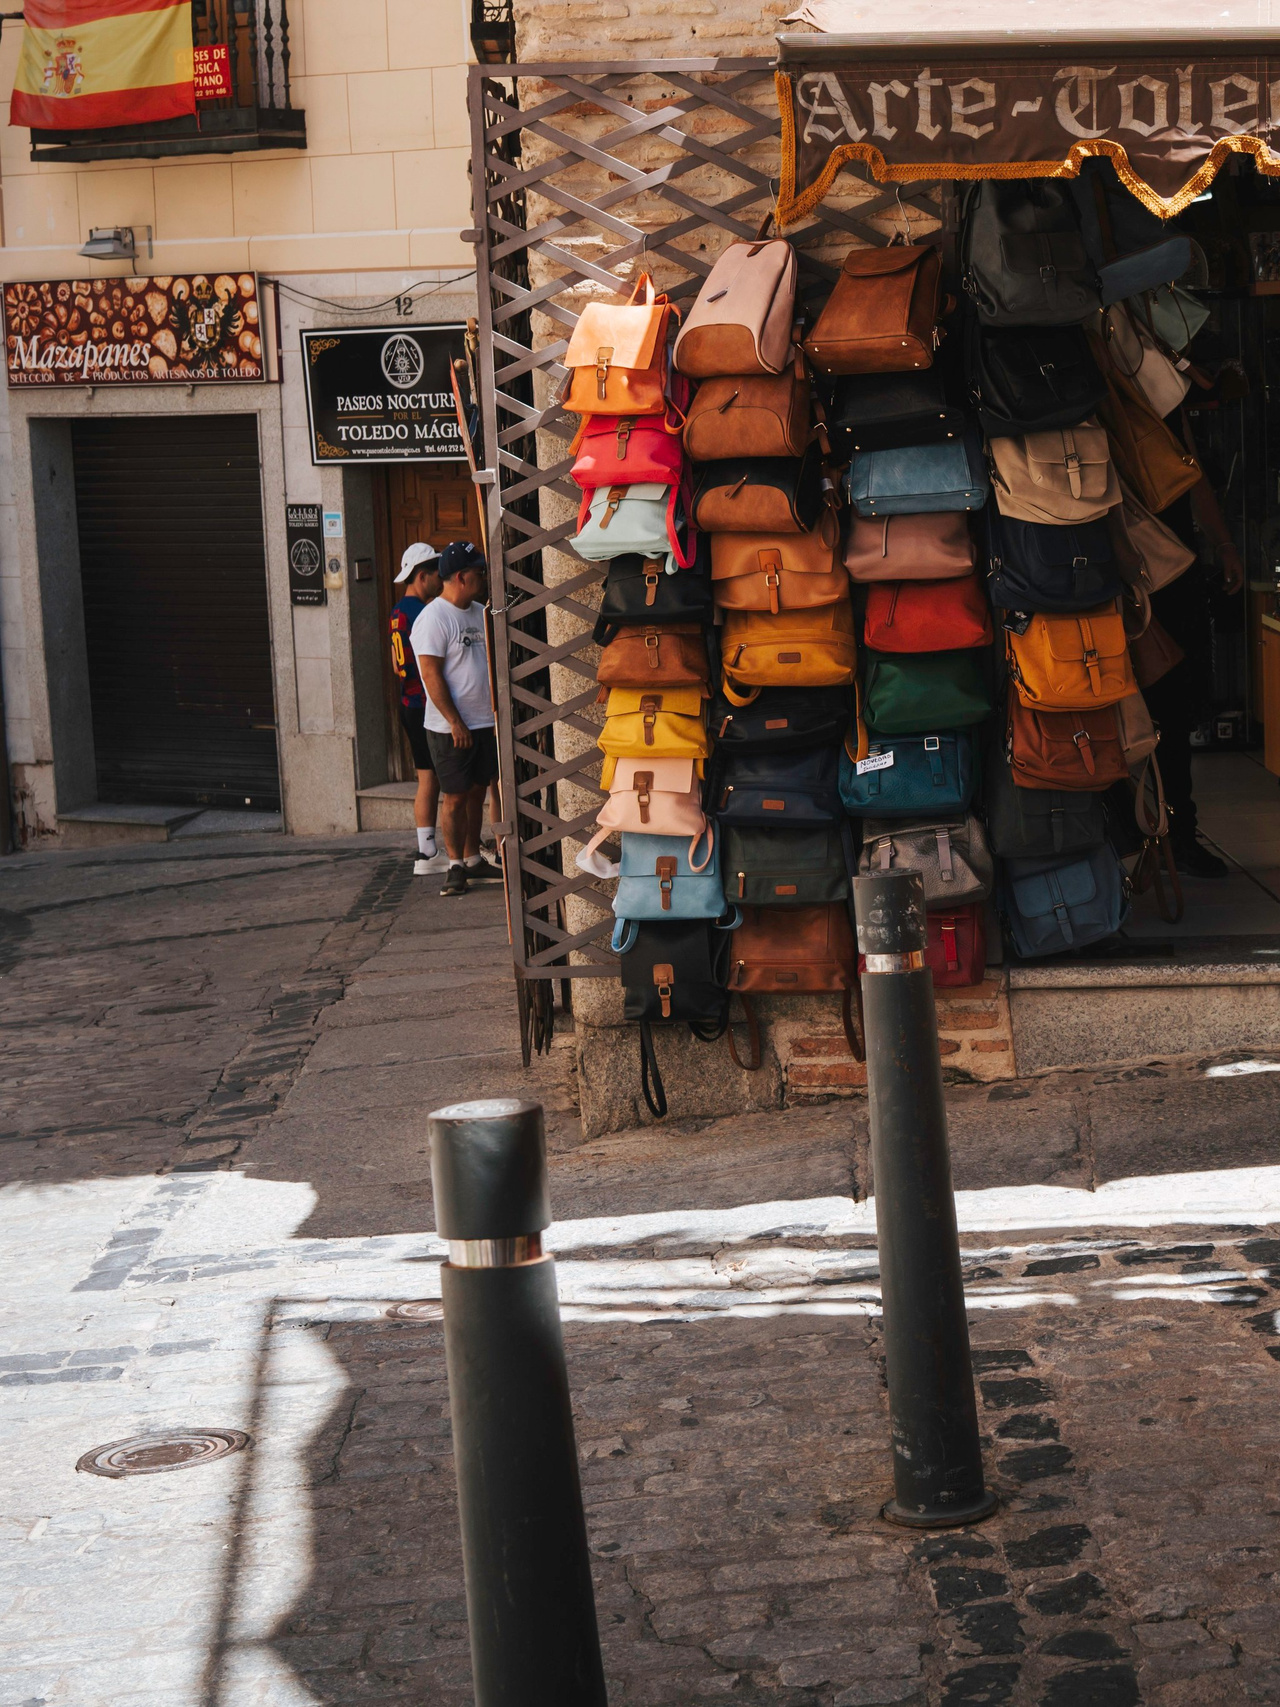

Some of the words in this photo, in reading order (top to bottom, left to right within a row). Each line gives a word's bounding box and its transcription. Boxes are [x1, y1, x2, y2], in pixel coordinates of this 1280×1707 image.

[213, 48, 226, 60] DE
[194, 74, 223, 87] PIANO
[394, 296, 413, 316] 12
[10, 335, 151, 379] Mazapanes
[63, 371, 75, 382] DE
[92, 369, 149, 381] PRODUCTOS
[152, 368, 205, 380] ARTESANOS
[206, 367, 219, 379] DE
[221, 366, 261, 378] TOLEDO
[337, 395, 383, 411] PASEOS
[393, 412, 409, 420] POR
[412, 411, 422, 420] EL
[337, 424, 409, 441] TOLEDO
